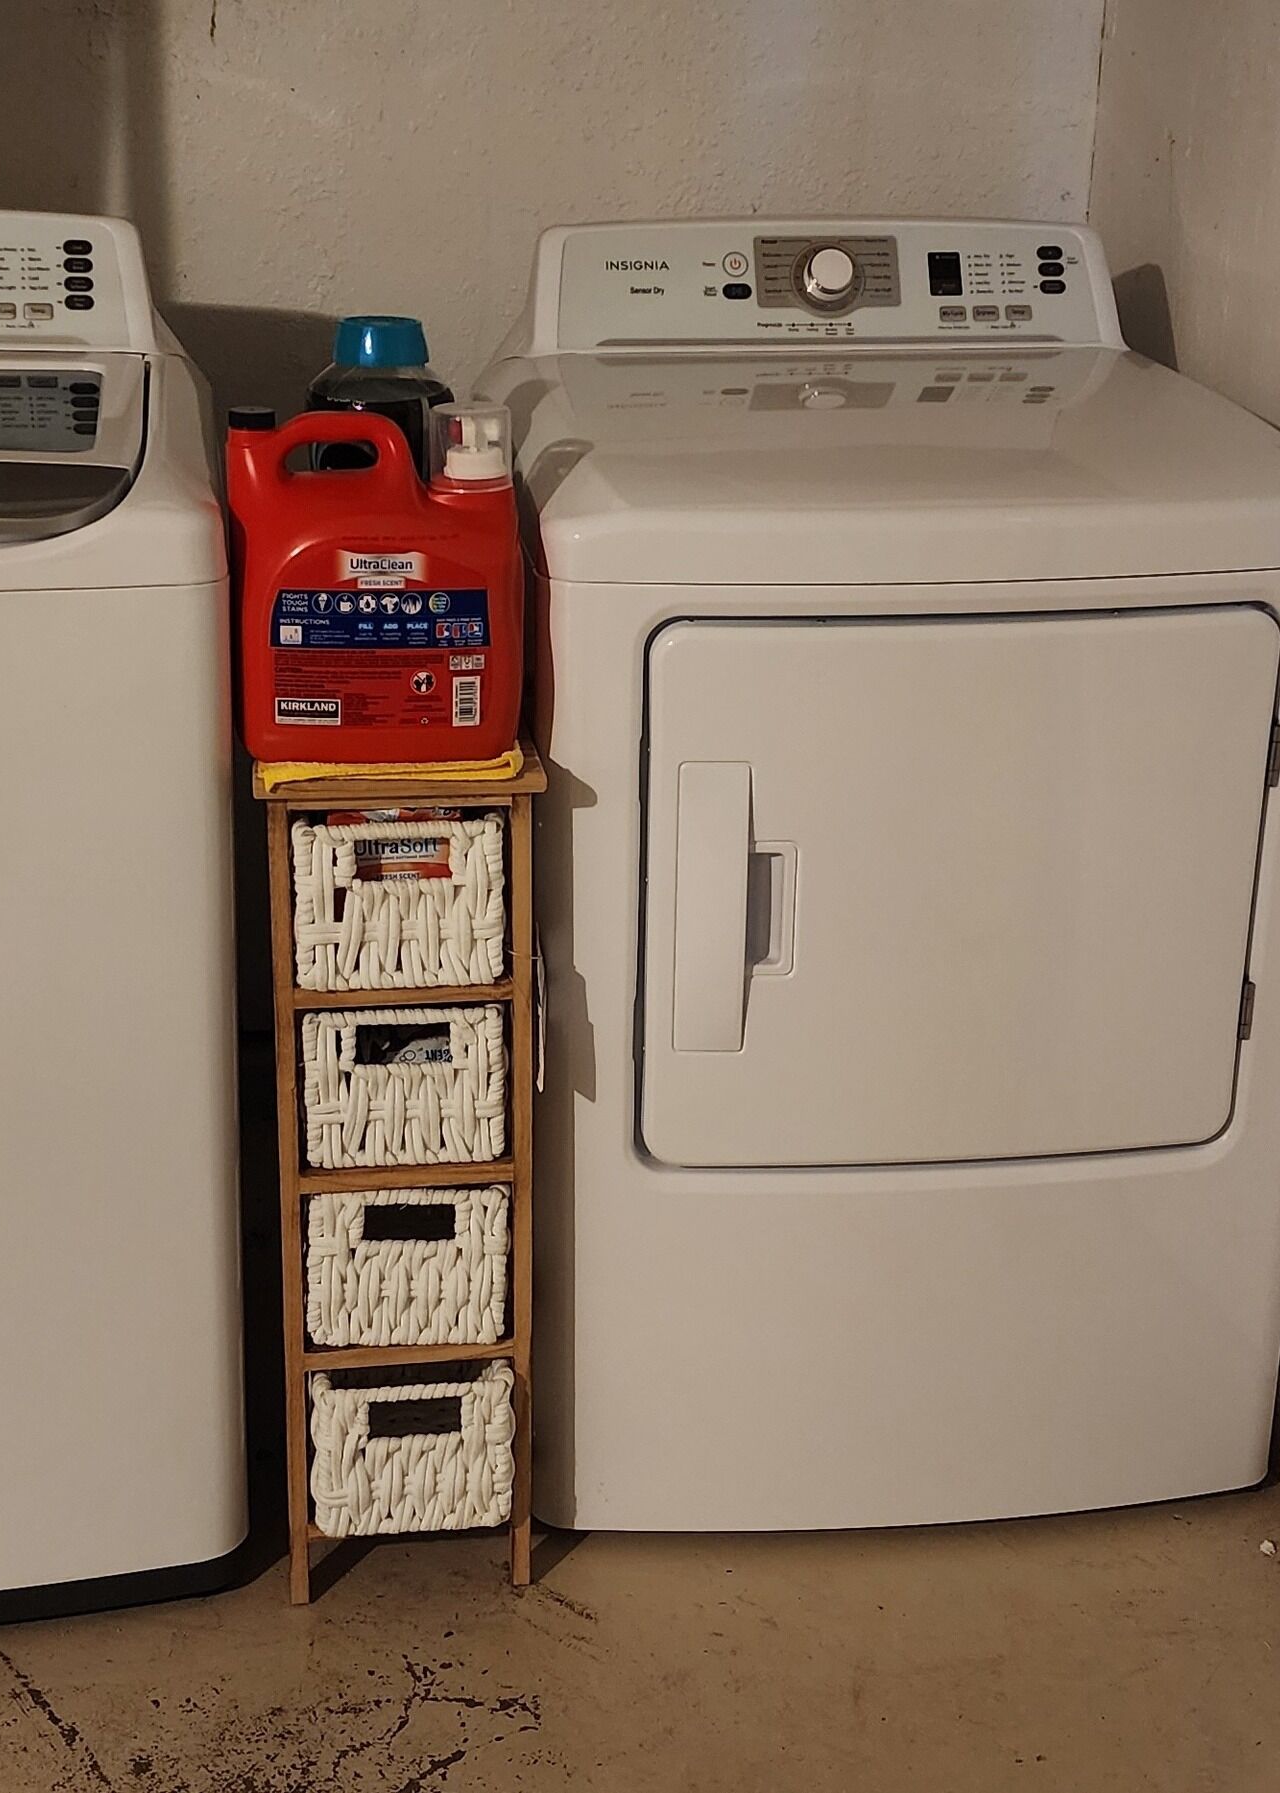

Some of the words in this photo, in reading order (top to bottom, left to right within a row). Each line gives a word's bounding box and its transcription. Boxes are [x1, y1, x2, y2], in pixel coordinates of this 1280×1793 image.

[605, 260, 670, 271] INSIGNIA
[630, 286, 652, 295] Sensor
[653, 286, 665, 296] Dry
[350, 558, 413, 570] UltraClean
[406, 622, 428, 630] PLACE
[280, 701, 337, 712] KIRKLAND
[354, 837, 438, 856] UltraSoft
